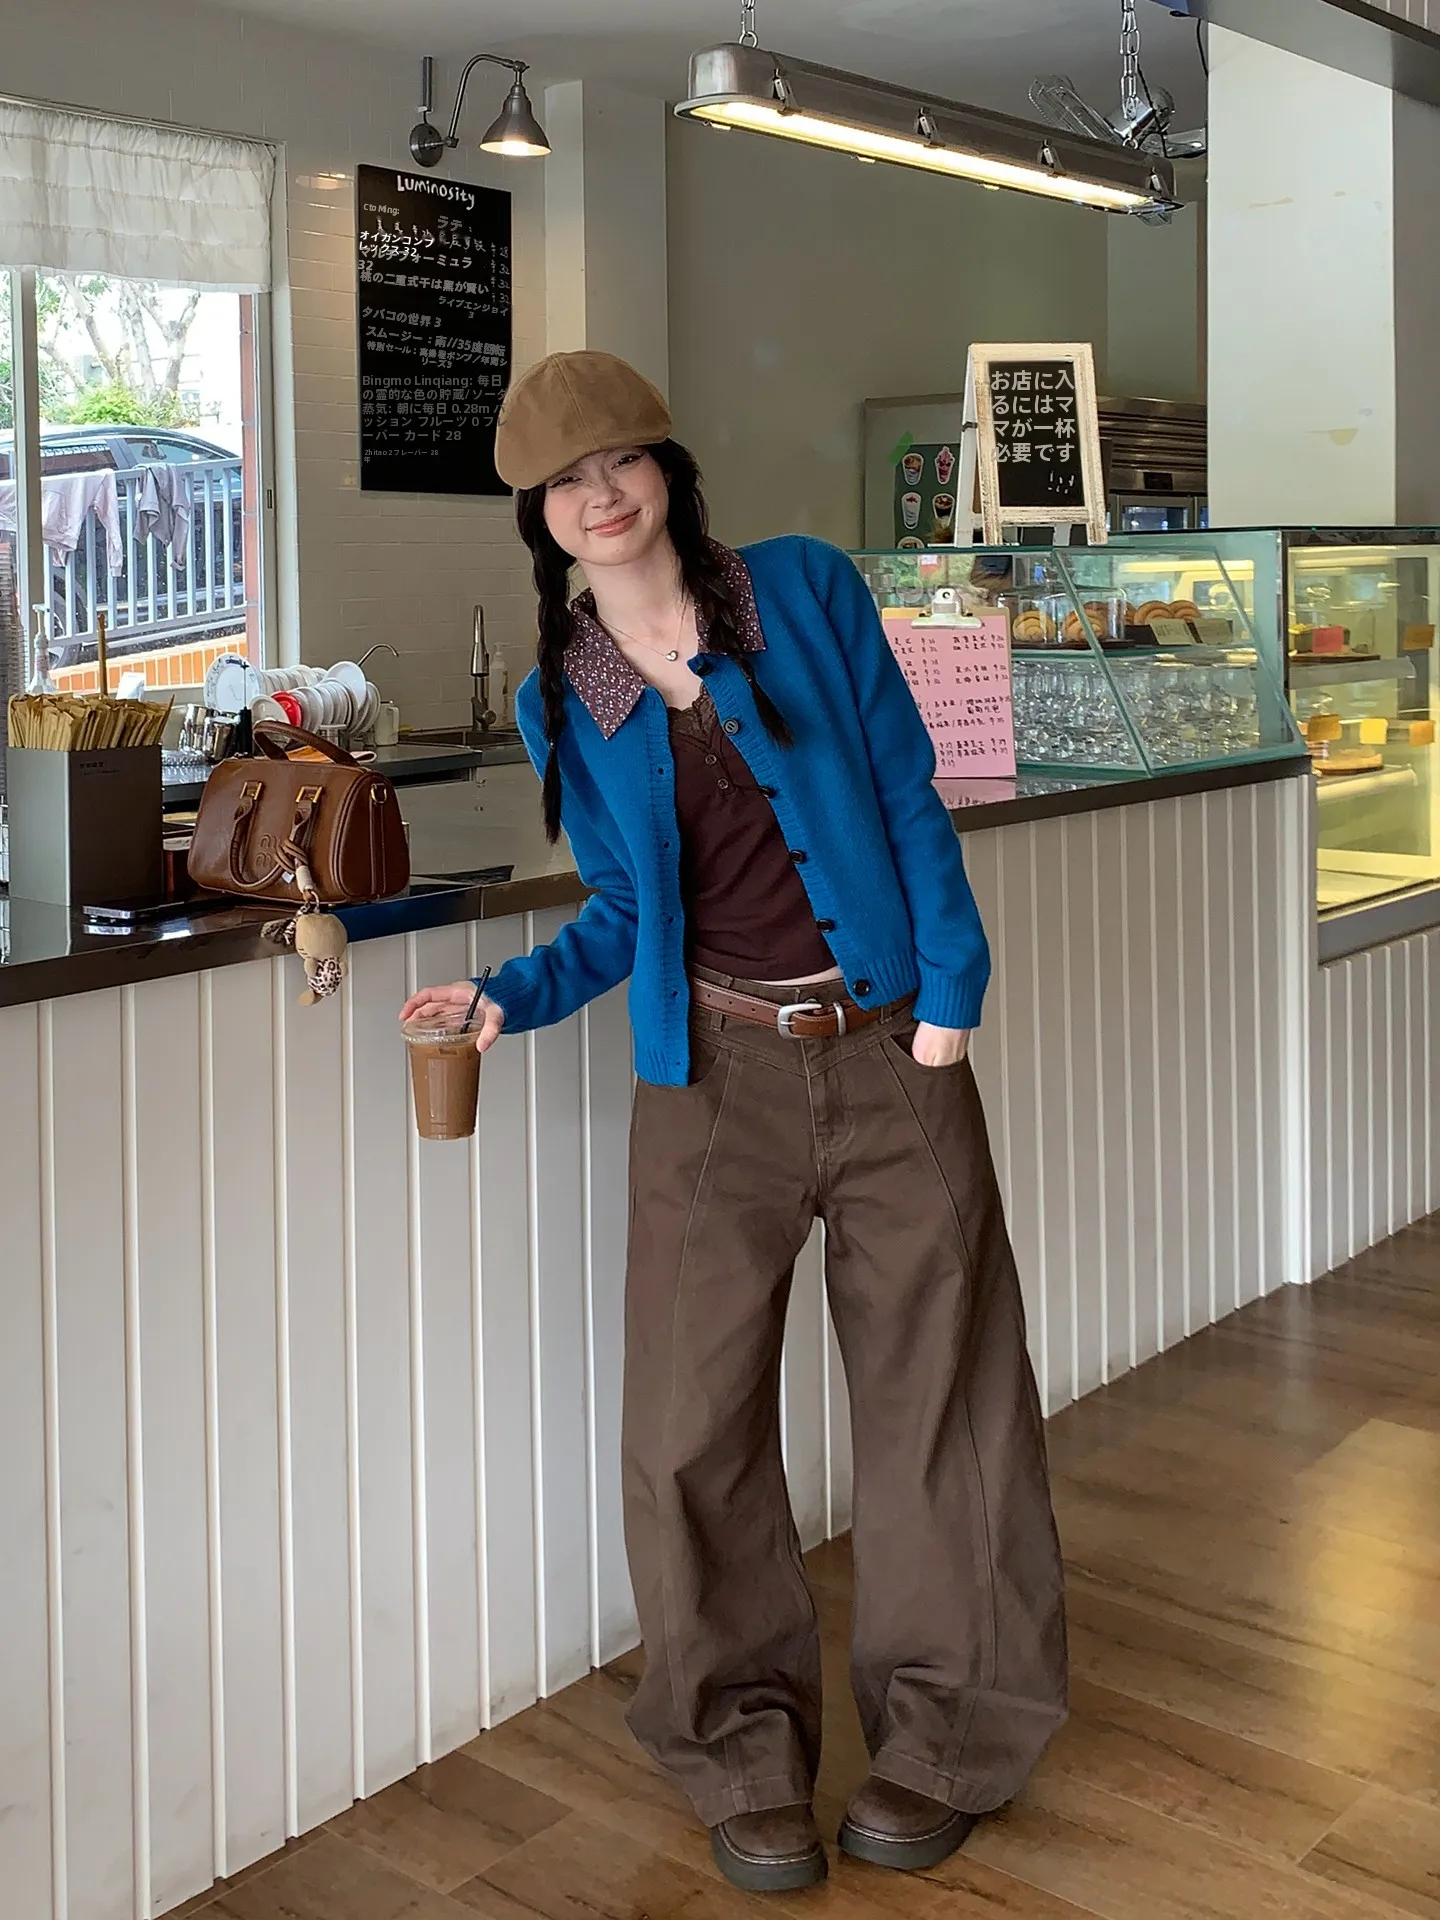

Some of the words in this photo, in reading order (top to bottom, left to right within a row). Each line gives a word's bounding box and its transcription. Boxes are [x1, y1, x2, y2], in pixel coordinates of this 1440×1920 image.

[397, 174, 475, 211] Luminosity
[414, 375, 473, 389] Linqiang:
[990, 369, 1075, 391] お店に入
[991, 394, 1074, 415] るにはマ
[445, 431, 462, 441] 28
[993, 417, 1076, 439] マが一杯
[994, 442, 1075, 463] 必要です
